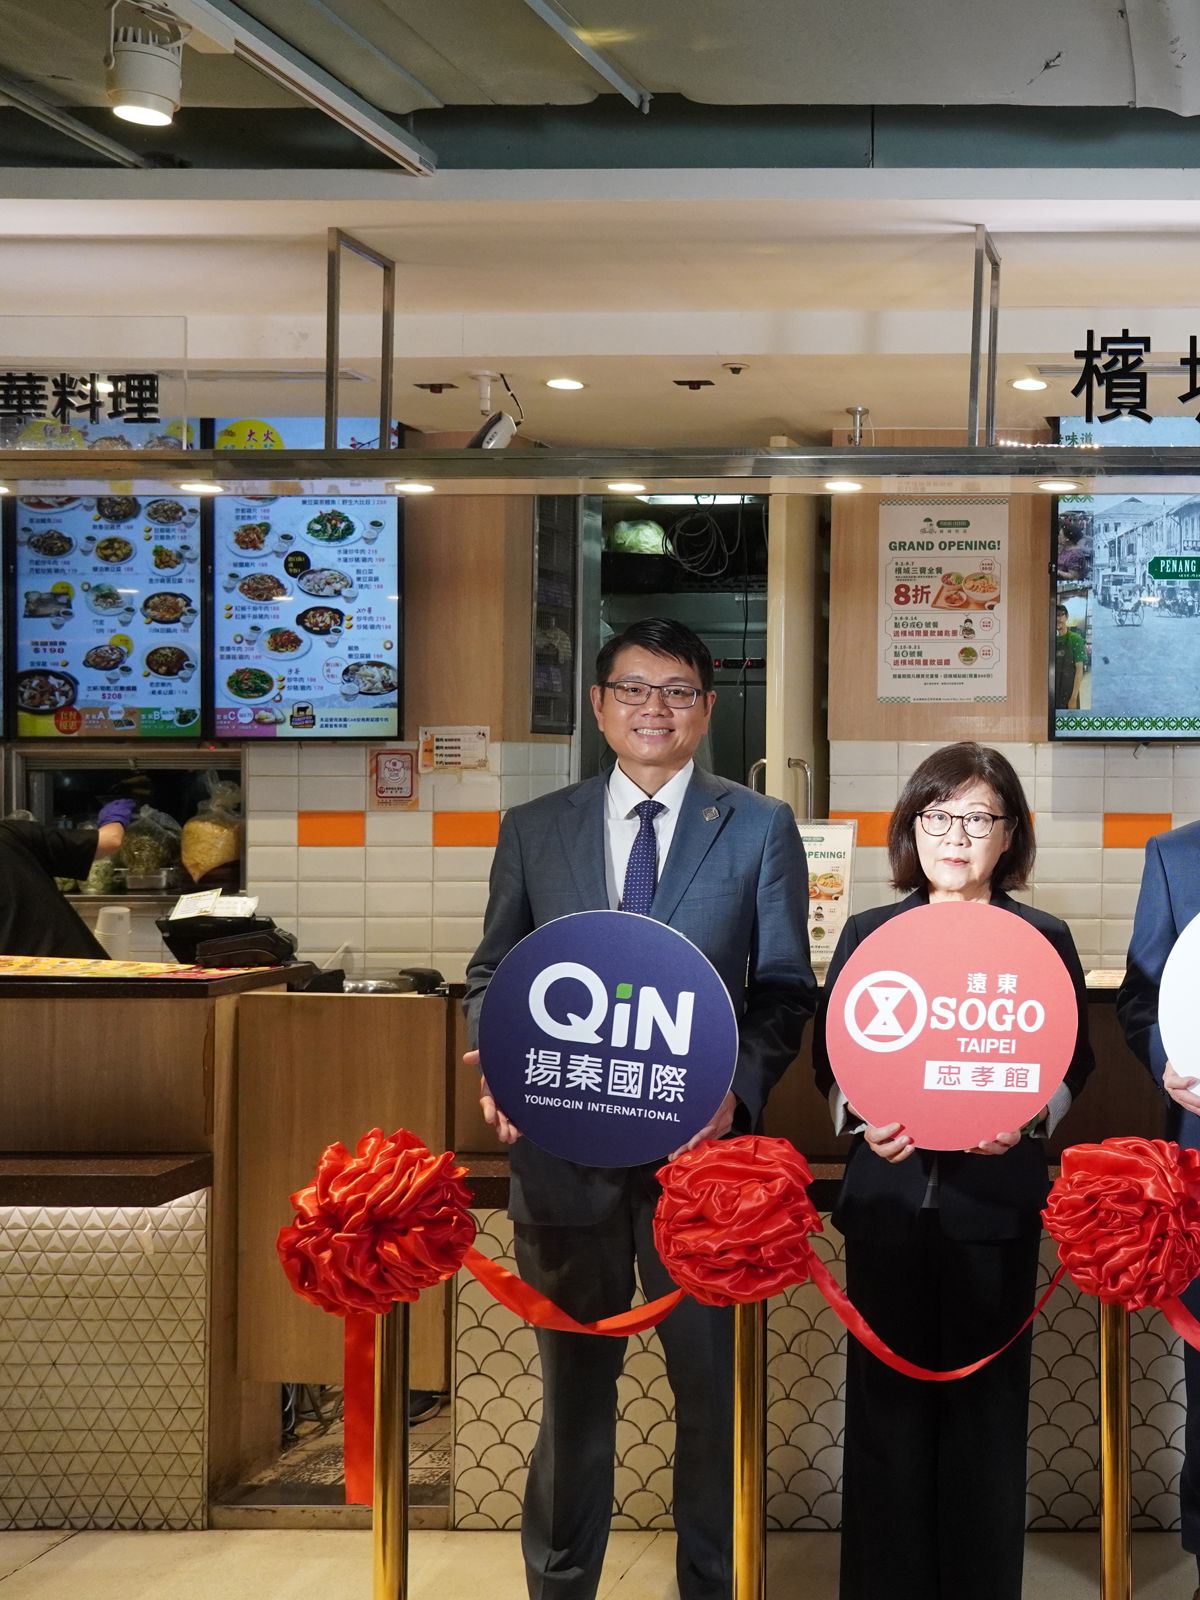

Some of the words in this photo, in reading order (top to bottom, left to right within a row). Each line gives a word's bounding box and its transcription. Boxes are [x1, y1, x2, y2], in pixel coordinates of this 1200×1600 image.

[0, 372, 160, 424] 華料理
[888, 541, 935, 551] GRAND
[938, 540, 1001, 551] OPENING!
[1160, 560, 1197, 573] PENANG
[894, 583, 932, 606] 8折
[806, 851, 846, 859] PENING!
[966, 972, 1019, 995] 遠東
[529, 961, 696, 1056] QiN
[930, 996, 1046, 1033] SOGO
[956, 1037, 1017, 1055] TAIPEI
[524, 1048, 688, 1103] 揚秦國際
[936, 1064, 1030, 1089] 忠孝館
[524, 1094, 584, 1111] YOUNGQIN
[587, 1102, 681, 1123] INTERNATIONAL
